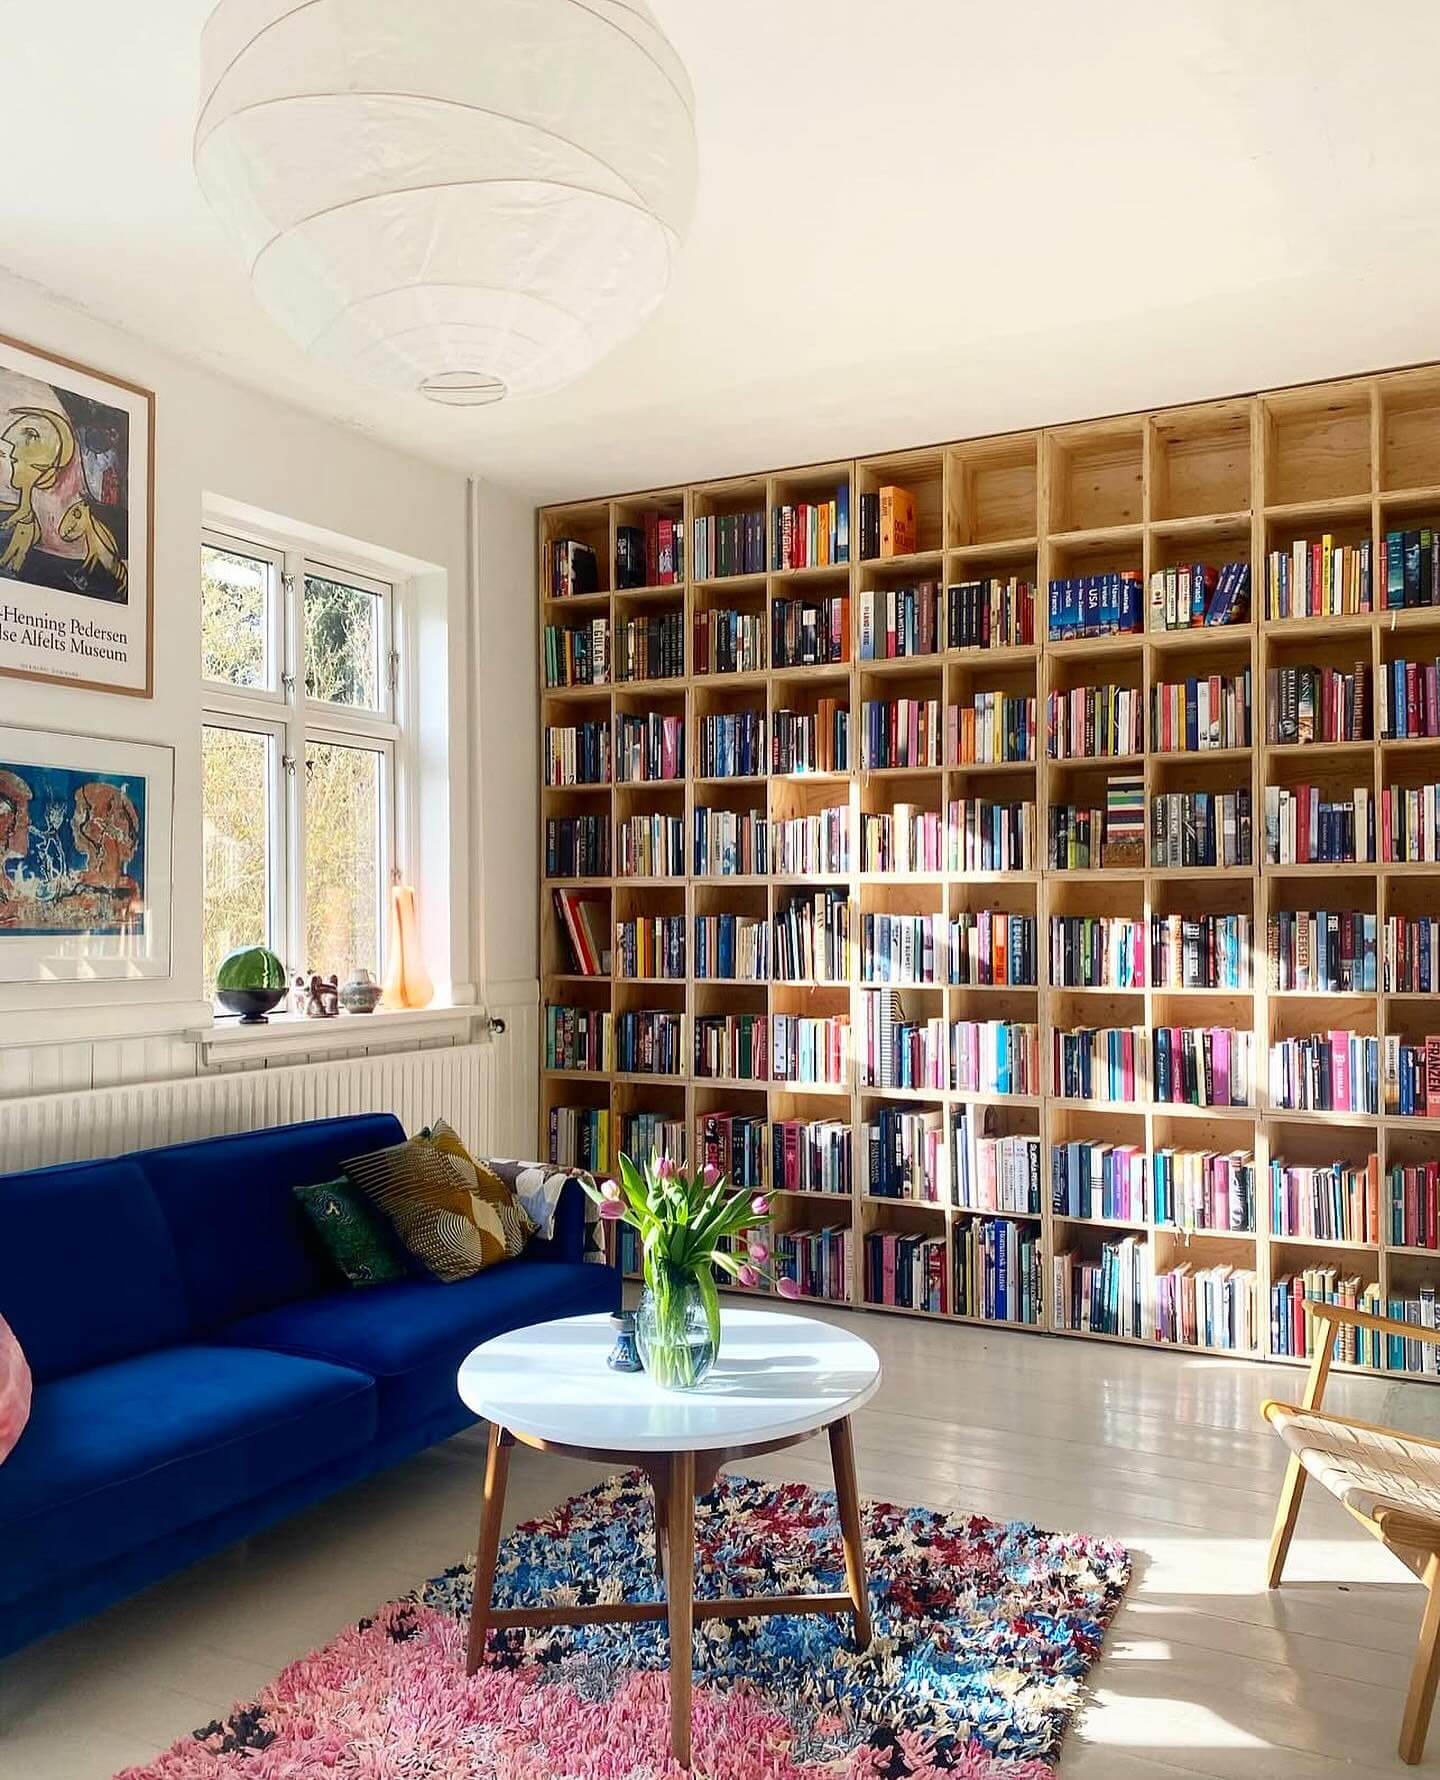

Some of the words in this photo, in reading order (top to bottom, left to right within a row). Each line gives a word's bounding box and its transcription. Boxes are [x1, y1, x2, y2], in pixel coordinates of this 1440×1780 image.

[1051, 591, 1059, 615] France
[1088, 588, 1098, 609] USA
[1122, 584, 1130, 614] Australia
[1194, 575, 1203, 603] Canada
[21, 629, 66, 652] Alfelts
[70, 638, 127, 662] Museum
[70, 618, 127, 644] Pedersen
[594, 630, 603, 662] GULAG
[1298, 915, 1308, 967] ANDERSEN
[1428, 1041, 1440, 1092] FRANZEN
